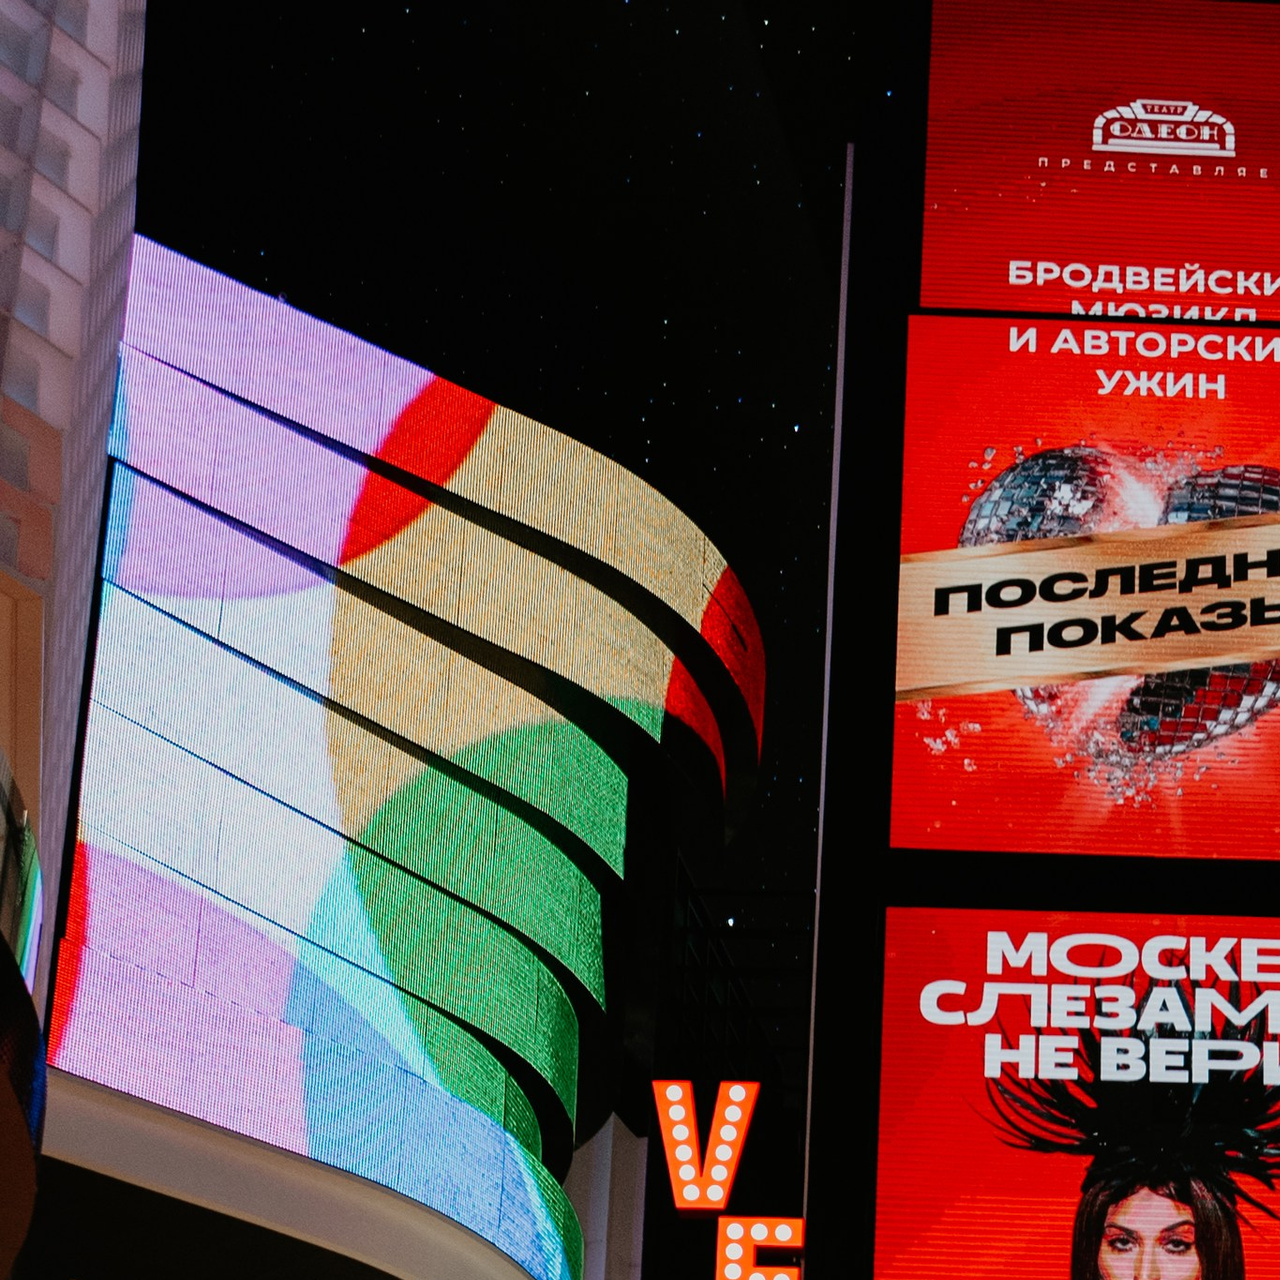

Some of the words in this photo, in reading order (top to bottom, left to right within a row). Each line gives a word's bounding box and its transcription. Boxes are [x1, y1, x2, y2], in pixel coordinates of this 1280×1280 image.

[1110, 121, 1218, 141] ОДЕОН
[1009, 327, 1036, 353] И
[1096, 369, 1226, 400] УЖИН
[984, 1033, 1079, 1080] НЕ
